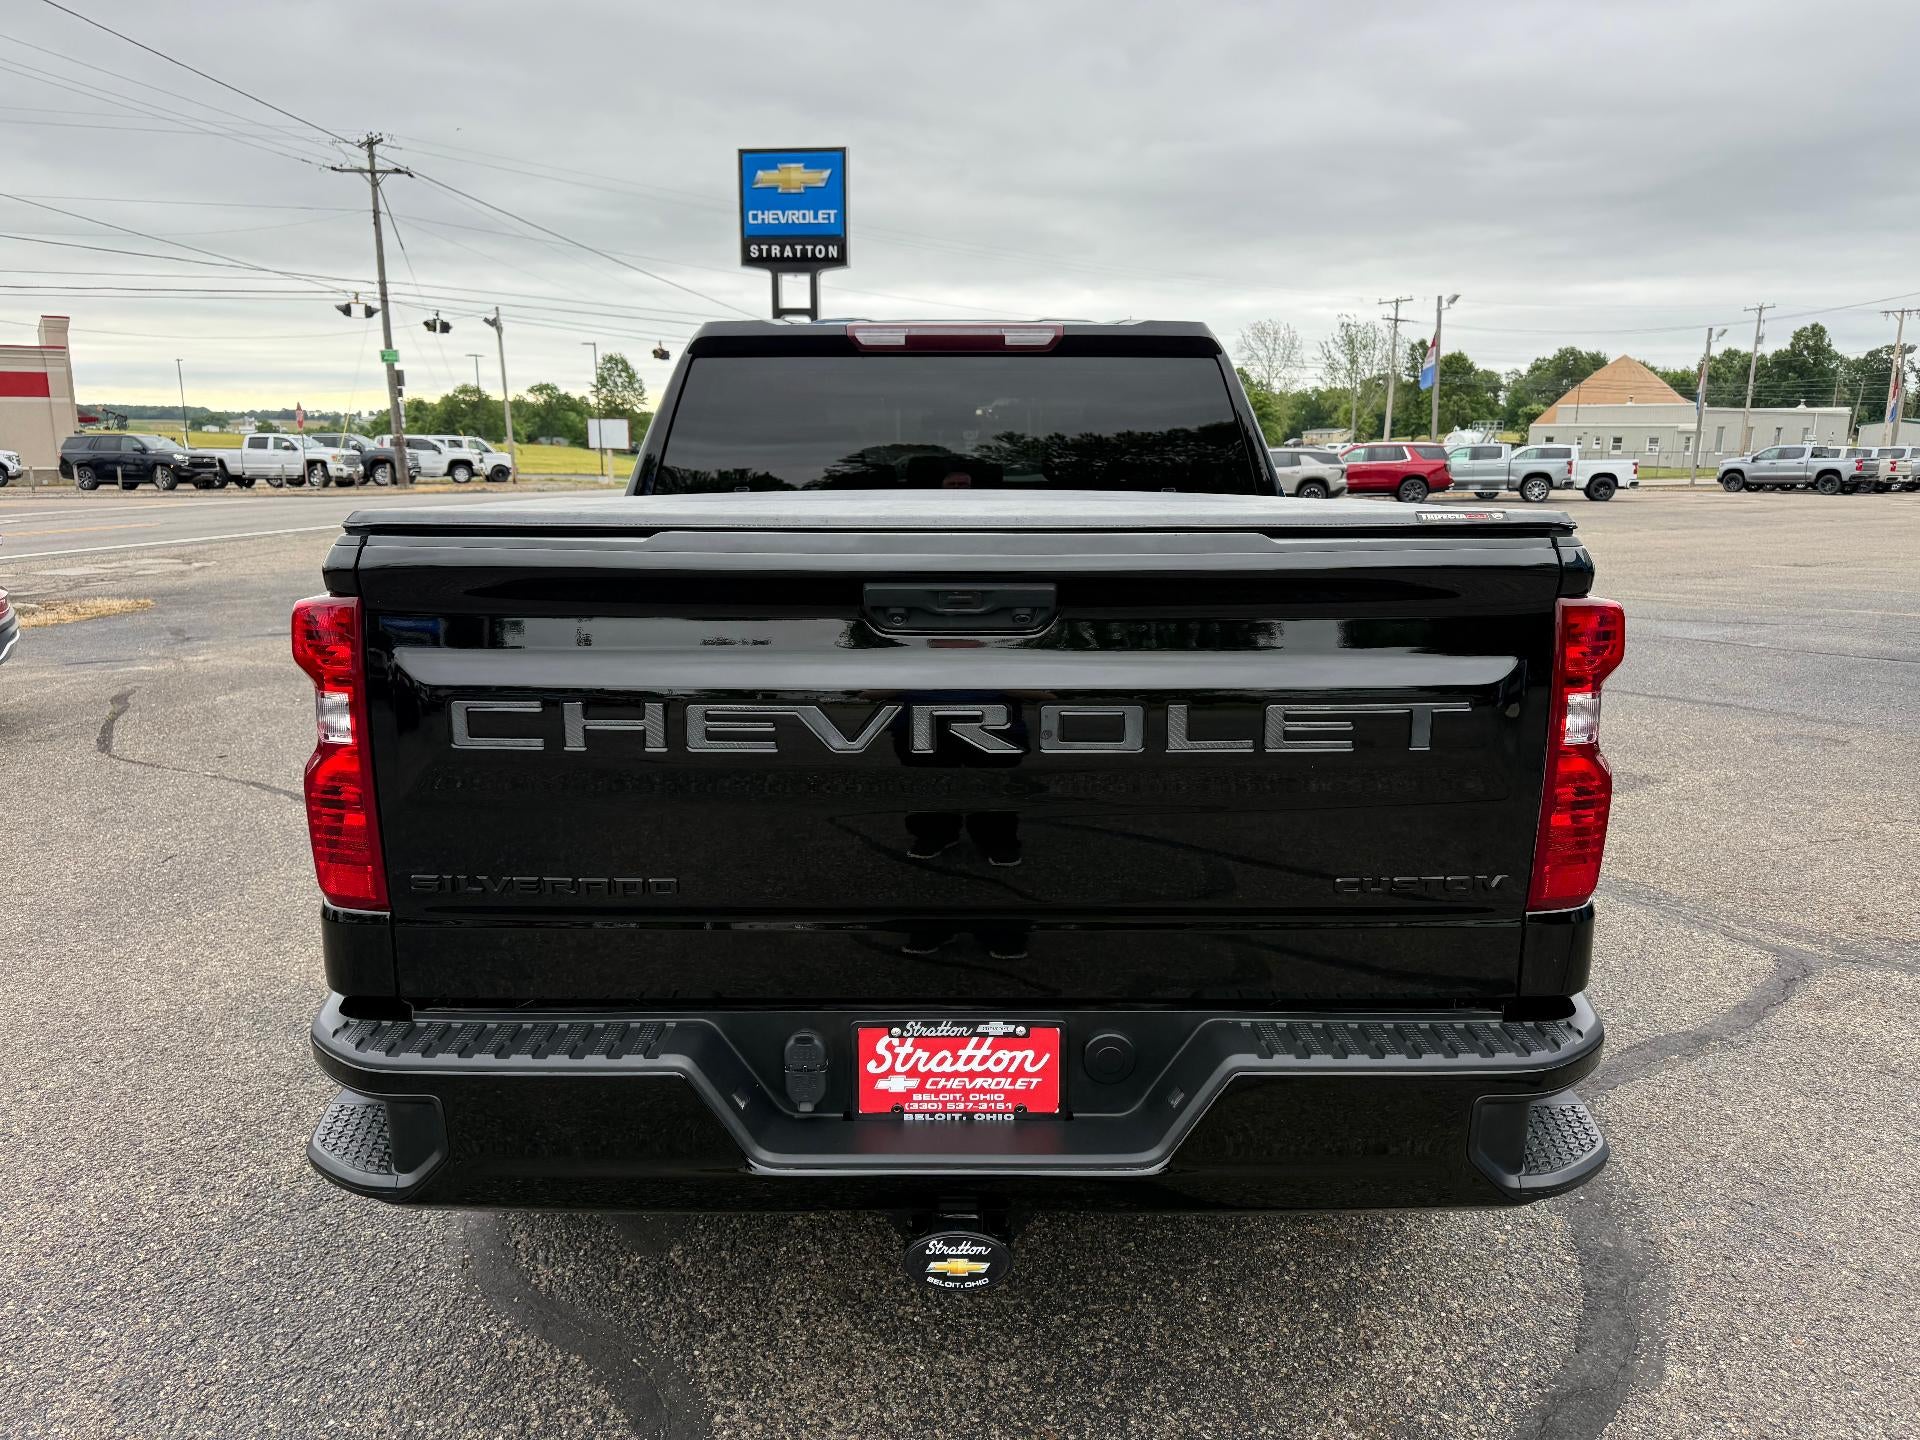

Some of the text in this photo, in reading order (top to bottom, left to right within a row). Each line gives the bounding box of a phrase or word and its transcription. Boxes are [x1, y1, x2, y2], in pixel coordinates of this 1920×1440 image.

[748, 210, 837, 224] CHEVROLET
[750, 245, 838, 258] STRATTON
[451, 701, 1472, 754] CHEVROLET
[409, 874, 680, 895] SILVERADO
[903, 1021, 973, 1037] Stratton
[866, 1036, 1050, 1073] Stratton
[925, 1077, 1042, 1090] CHEVROLET
[912, 1093, 1005, 1101] BELOIT, OHIO
[904, 1102, 1012, 1110] (330) 537-3151
[973, 1113, 1015, 1121] OHIO
[925, 1240, 991, 1255] Stratton
[964, 1277, 990, 1288] OHIO
